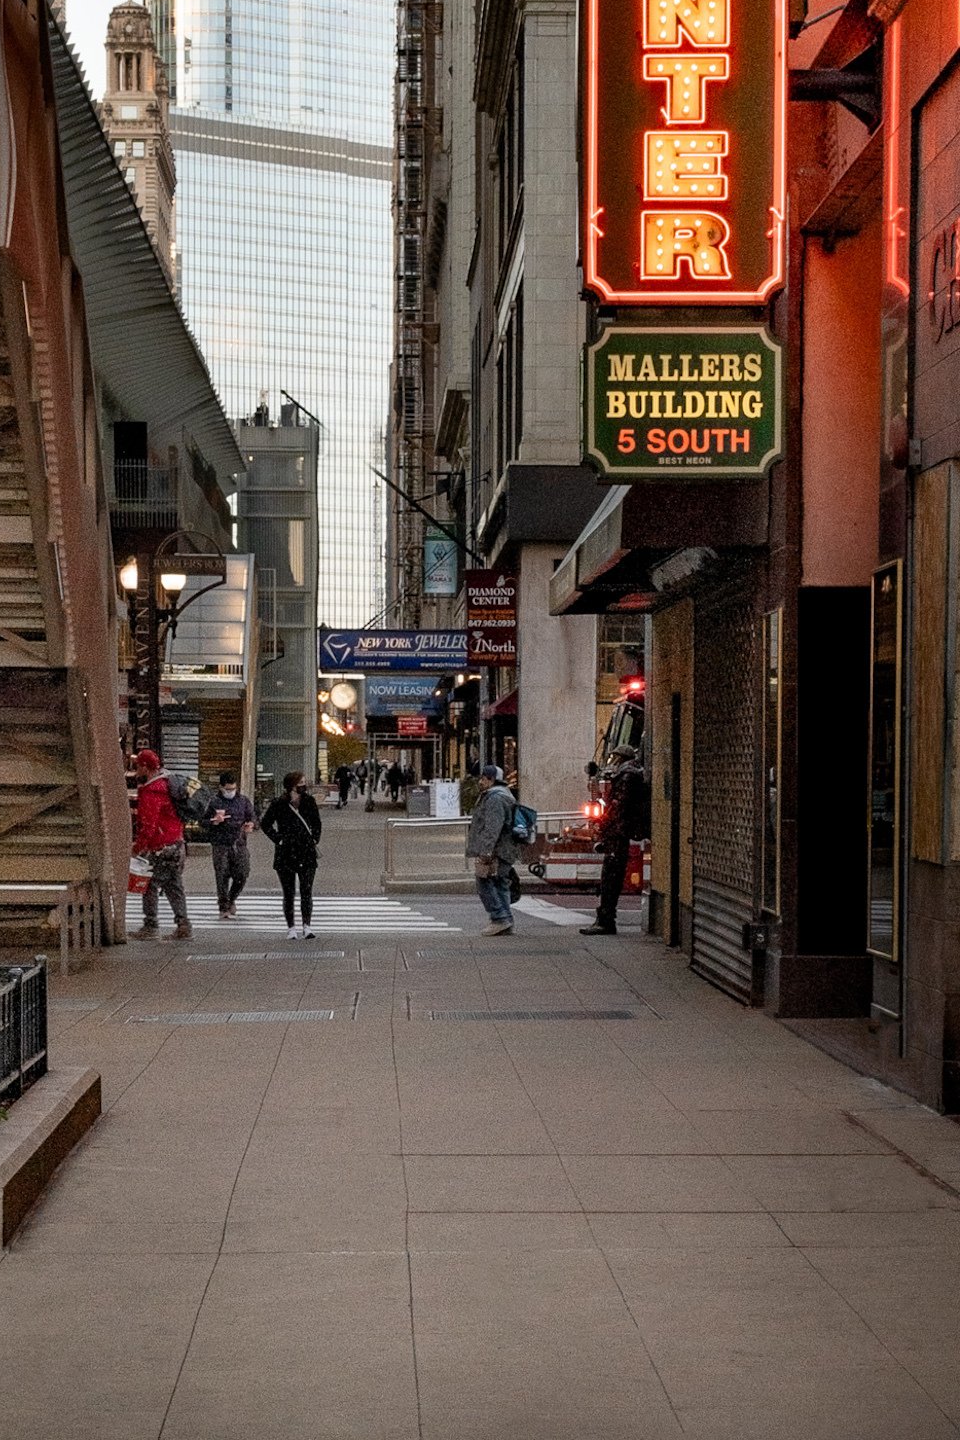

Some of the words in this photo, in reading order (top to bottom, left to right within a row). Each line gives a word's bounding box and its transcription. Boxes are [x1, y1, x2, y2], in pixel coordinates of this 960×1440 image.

[606, 353, 763, 383] MALLERS
[605, 390, 764, 419] BUILDING
[616, 428, 637, 454] 5
[646, 427, 751, 455] SOUTH
[658, 457, 684, 465] BEST
[685, 456, 712, 465] NEON
[468, 587, 515, 597] DIAMOND
[472, 596, 510, 606] CENTER
[354, 637, 383, 650] NEW
[384, 637, 413, 650] YORK
[369, 685, 397, 695] NOW
